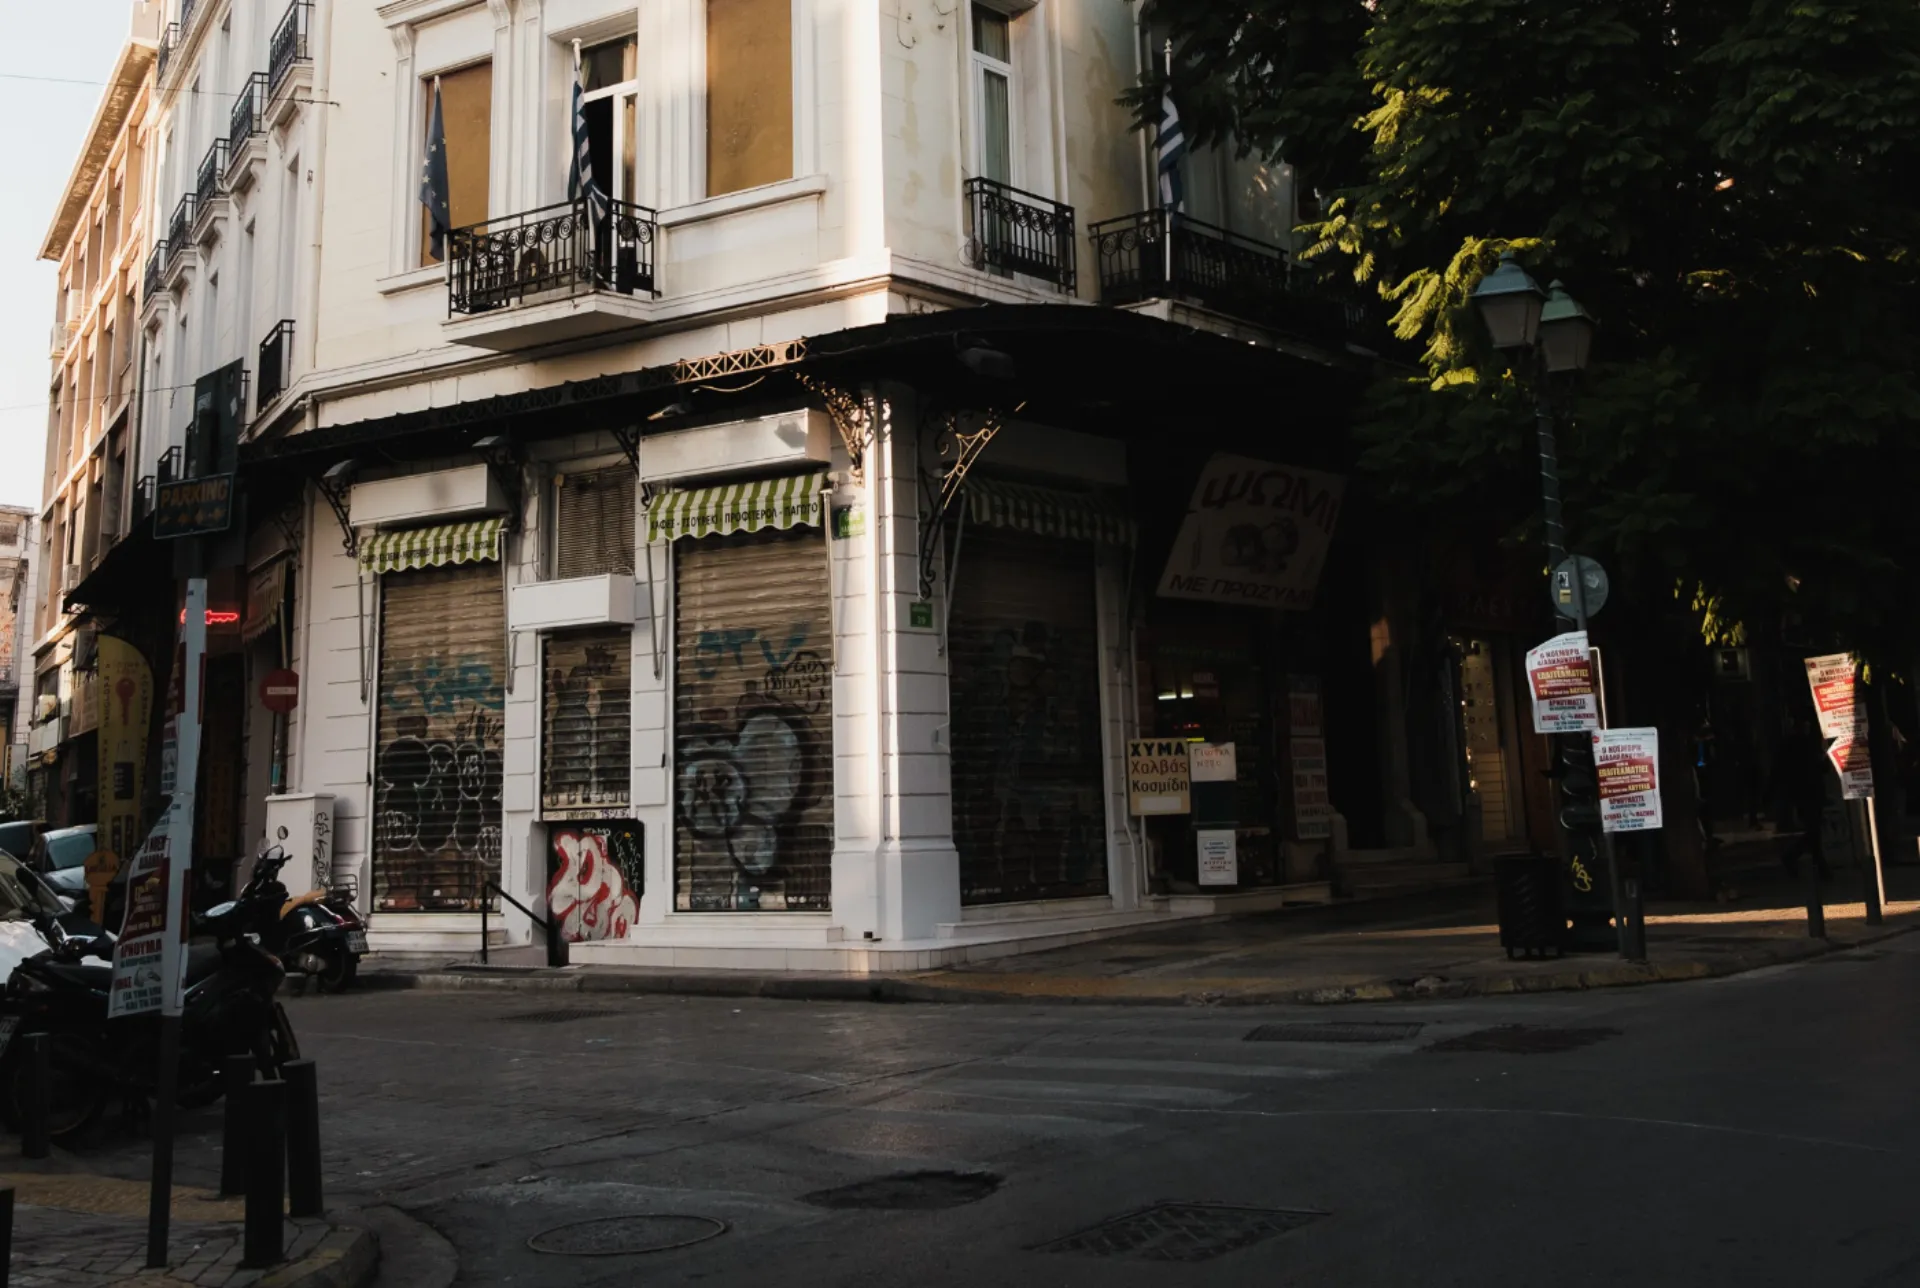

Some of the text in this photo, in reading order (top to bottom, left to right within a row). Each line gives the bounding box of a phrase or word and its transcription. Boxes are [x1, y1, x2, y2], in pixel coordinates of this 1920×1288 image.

[160, 479, 228, 508] PARKING
[1201, 470, 1338, 534] ΨΩΜΙ
[1169, 574, 1313, 605] ΜΕ ΠΡΟΖΥΜΙ
[1130, 742, 1185, 756] ΧΥΜΑ
[1131, 758, 1187, 775] Χαλβάς
